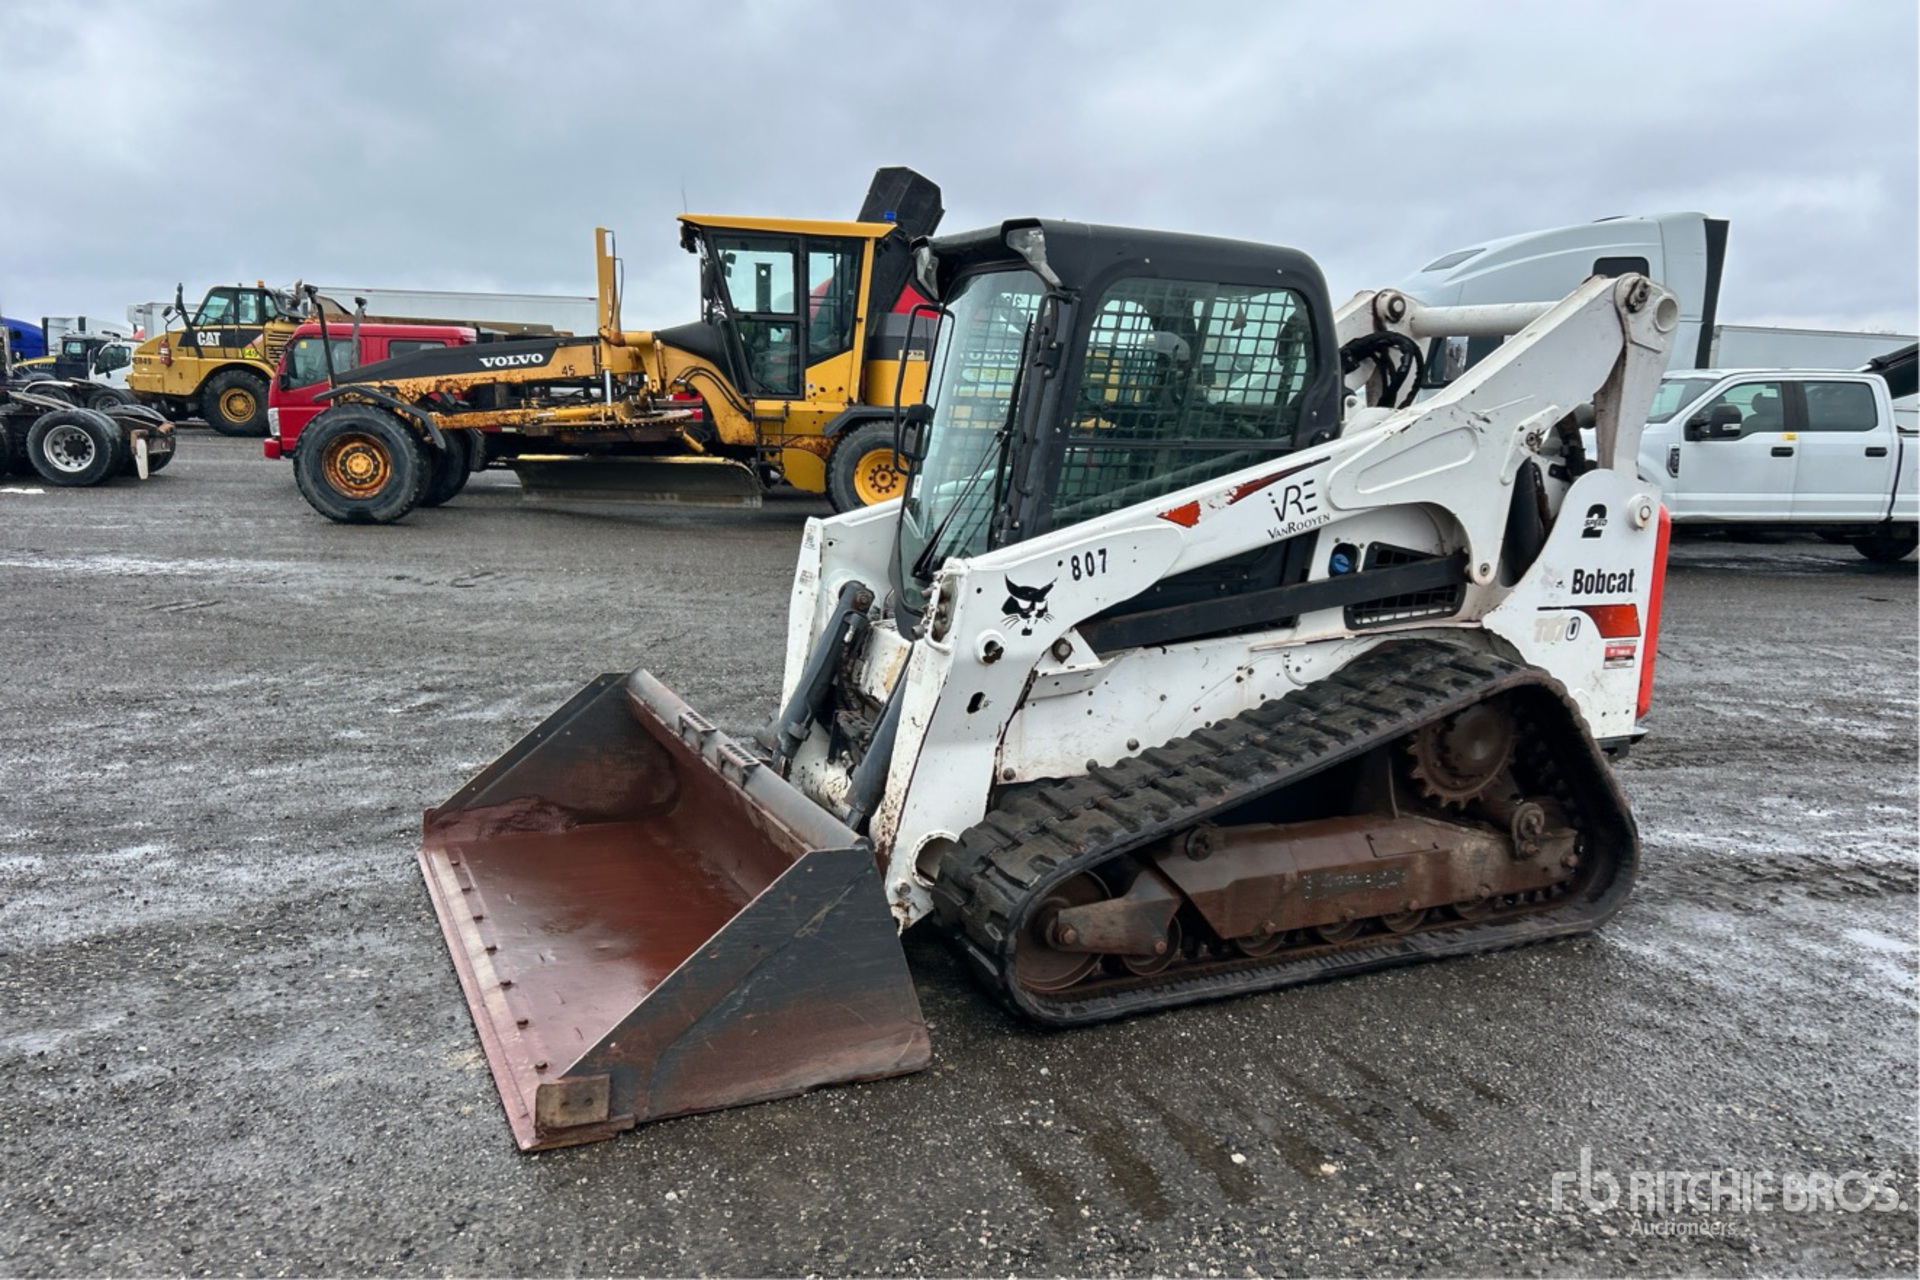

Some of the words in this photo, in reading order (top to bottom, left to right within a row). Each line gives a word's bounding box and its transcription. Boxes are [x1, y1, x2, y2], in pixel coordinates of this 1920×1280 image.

[197, 332, 221, 346] CAT
[479, 353, 543, 368] VOLVO
[562, 364, 575, 376] 45
[1581, 503, 1607, 538] 2
[1584, 519, 1608, 527] SPEED
[1071, 548, 1107, 581] 807
[1571, 568, 1635, 595] Bobcat
